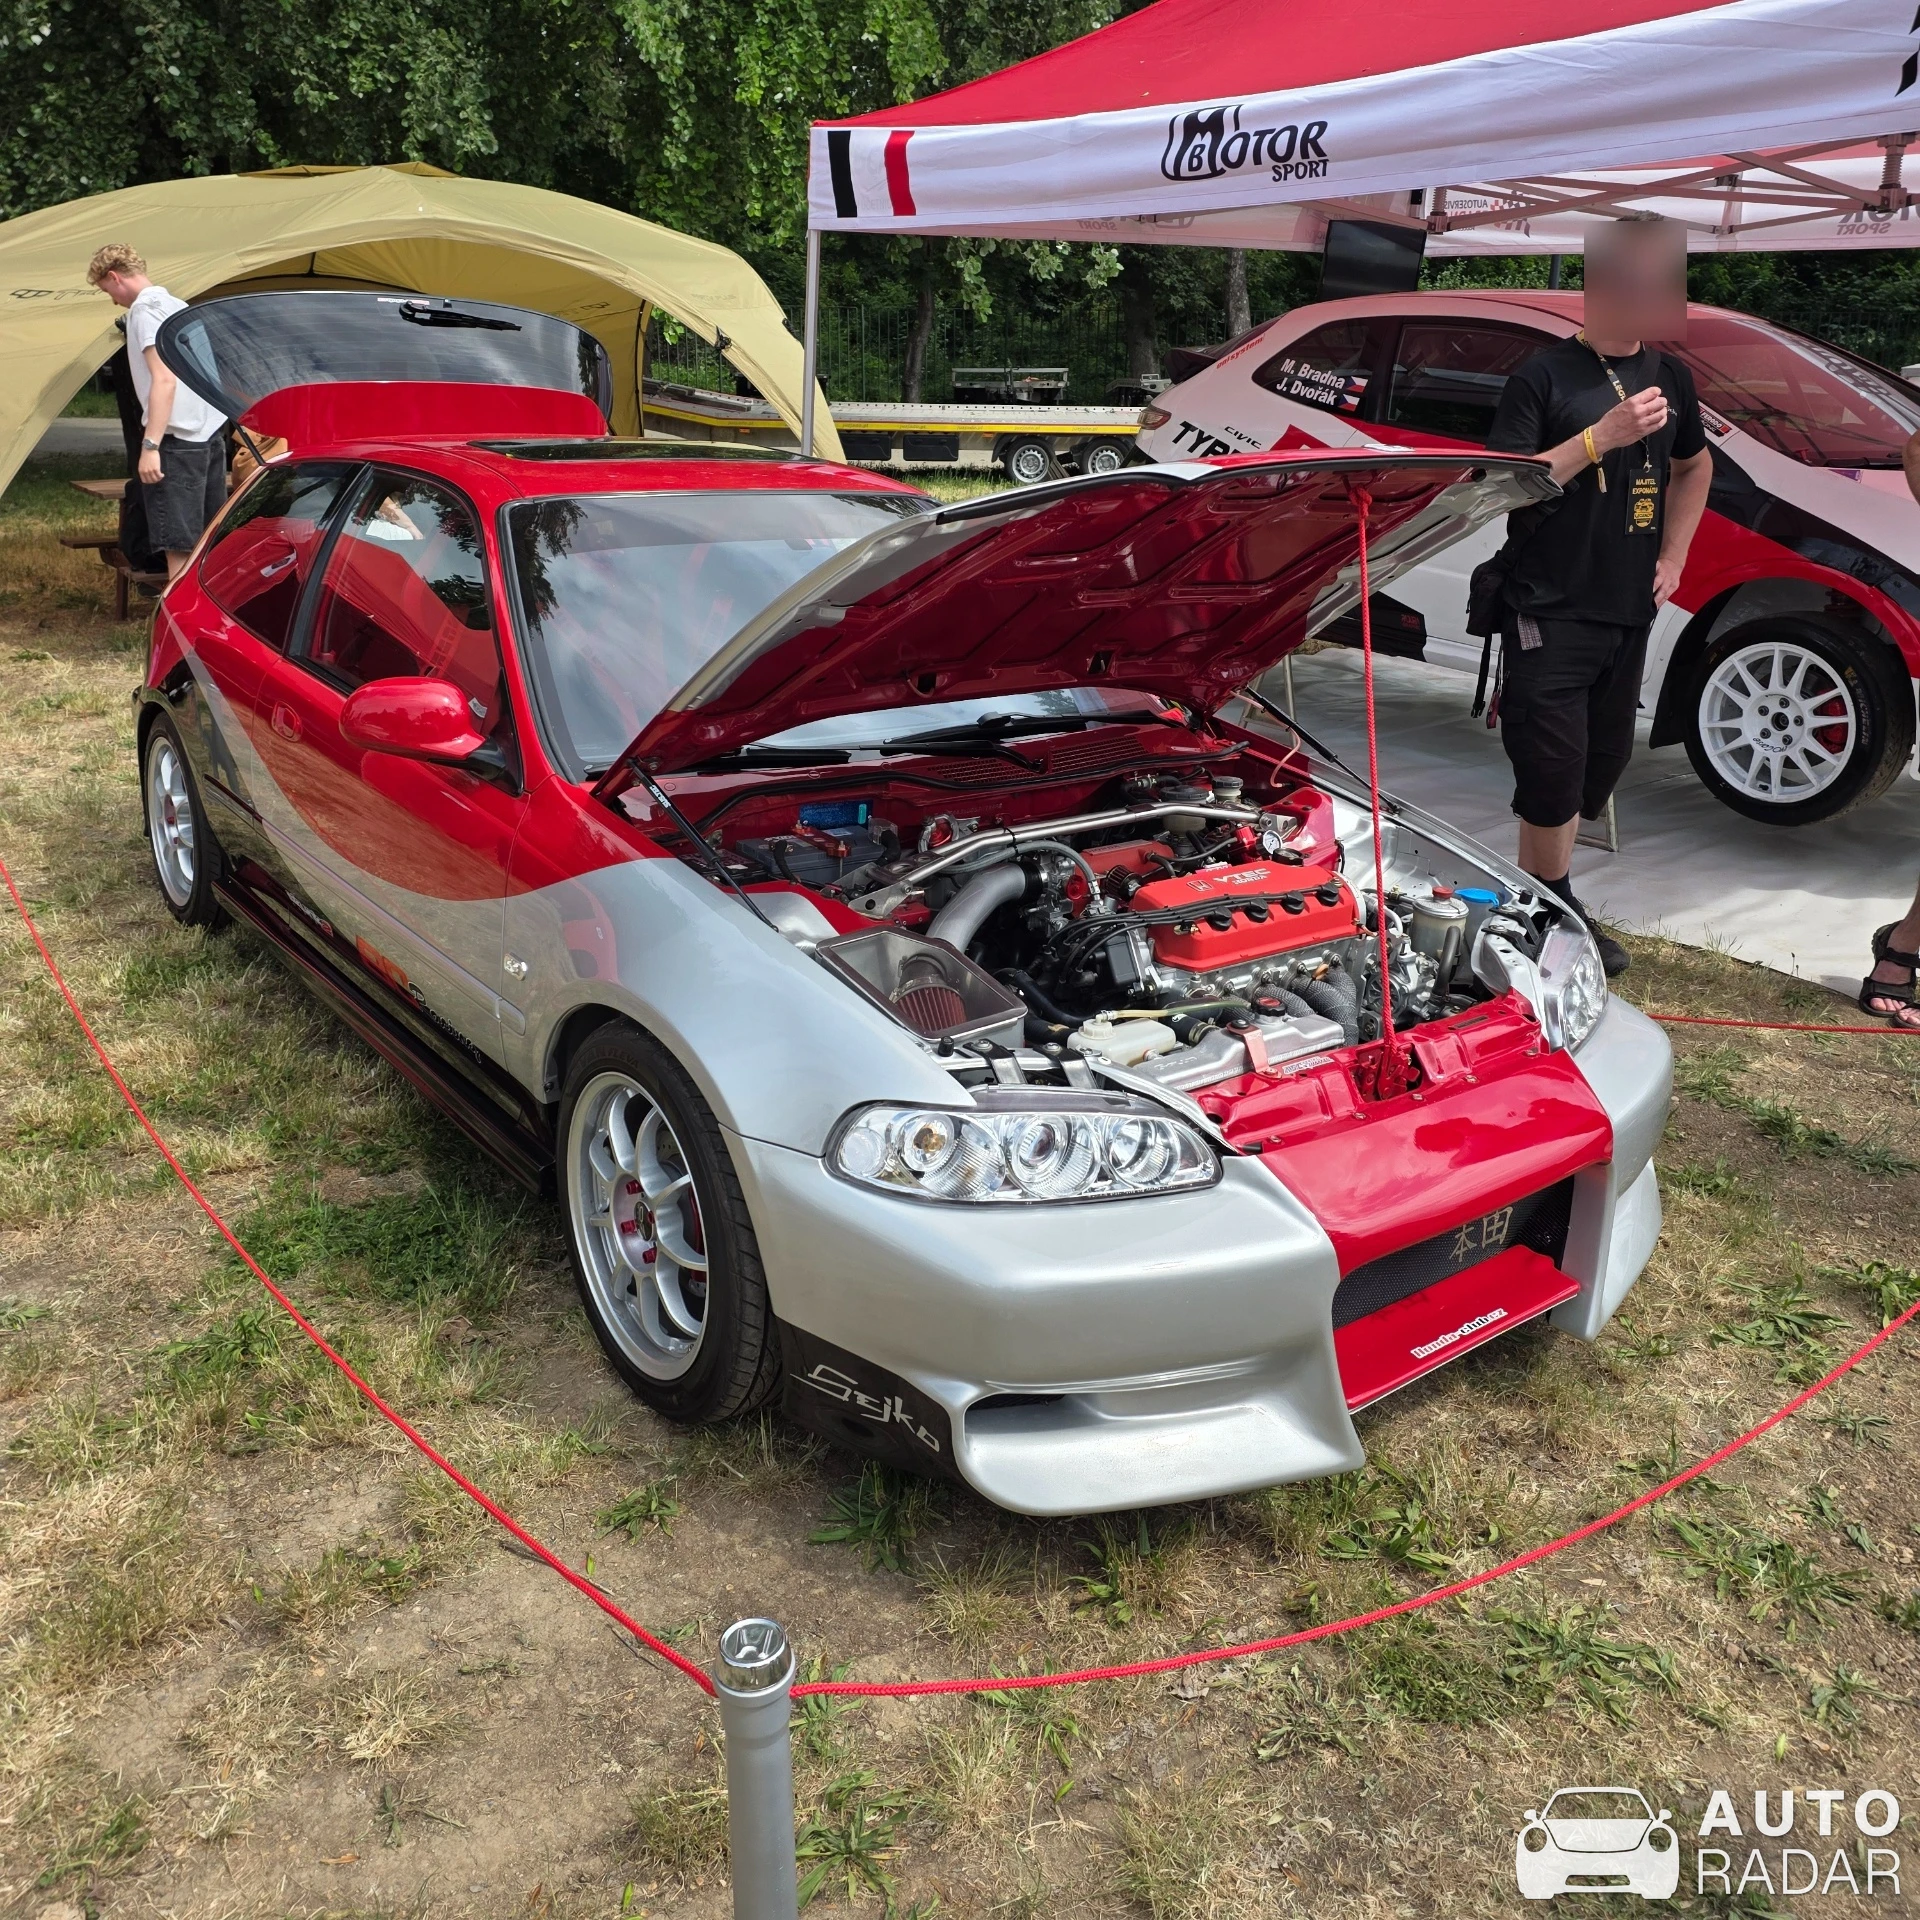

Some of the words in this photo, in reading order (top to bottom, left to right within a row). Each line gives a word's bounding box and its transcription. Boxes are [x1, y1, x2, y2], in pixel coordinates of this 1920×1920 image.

[1272, 159, 1329, 182] SPORT
[1280, 358, 1294, 375] M.
[1298, 363, 1346, 389] Bradna
[1276, 377, 1287, 392] J.
[1290, 380, 1338, 406] Dvořák
[1172, 420, 1243, 461] TYP
[1224, 426, 1262, 449] CIVIC
[1632, 486, 1658, 495] EXPONÁTU
[1635, 478, 1656, 486] MAJITEL
[1213, 868, 1271, 883] VTEC
[1449, 1206, 1514, 1262] 本田
